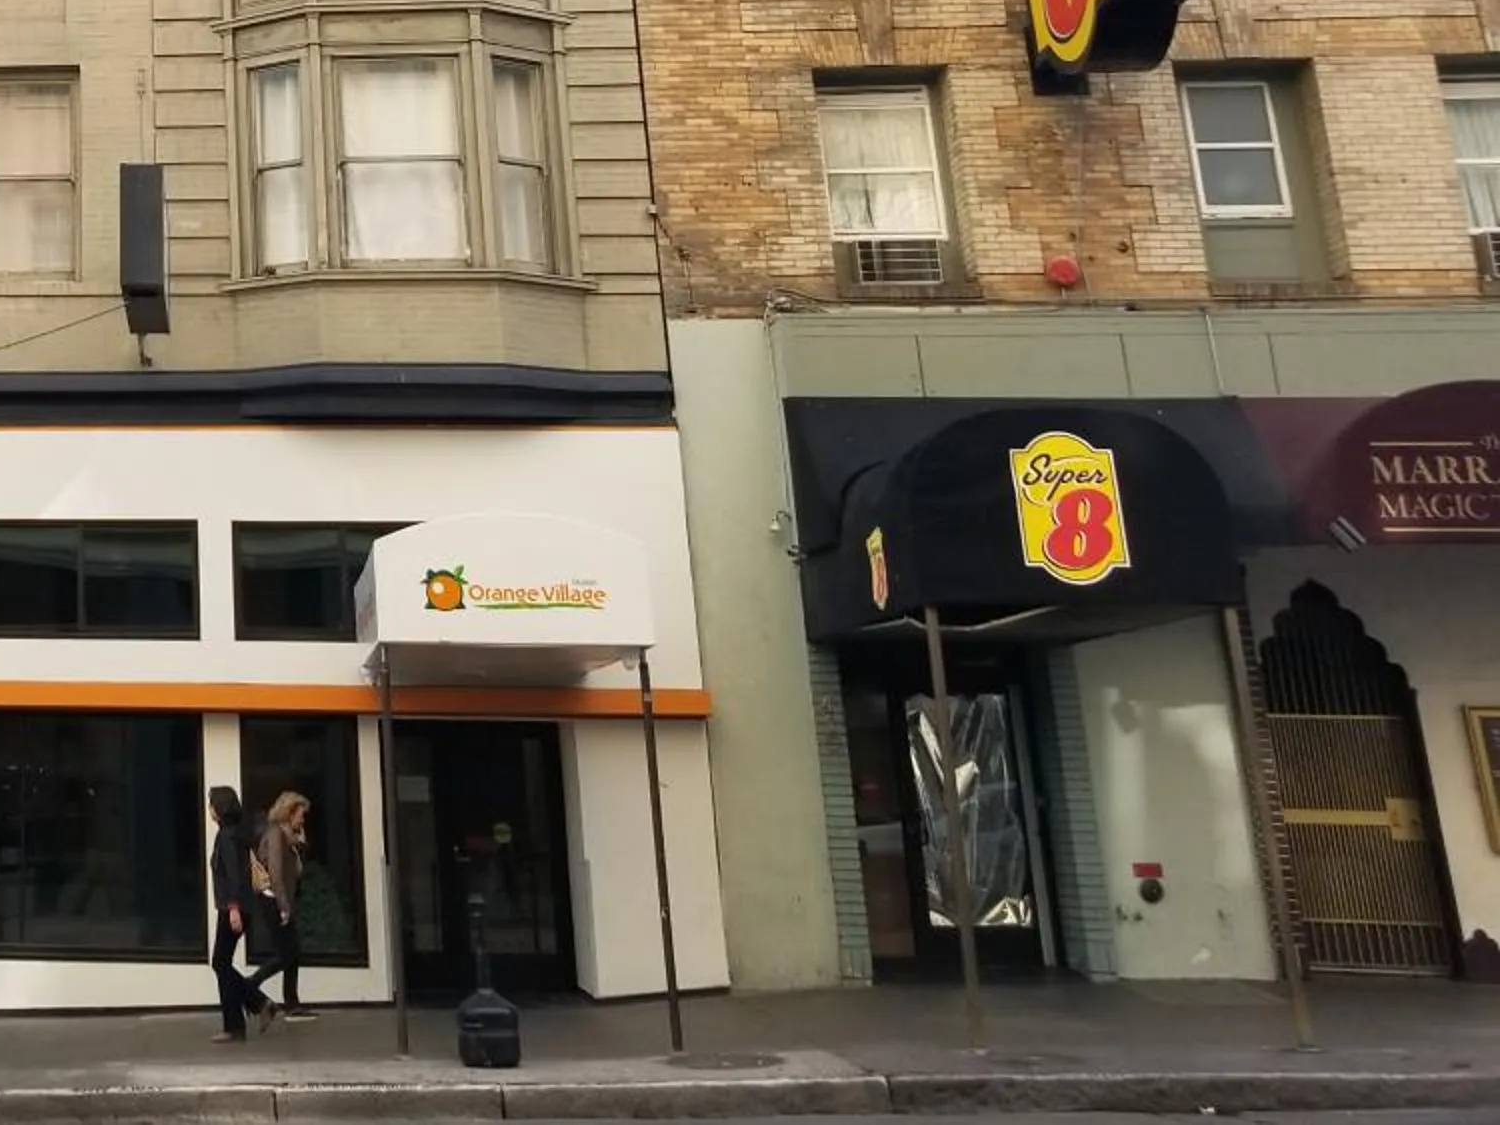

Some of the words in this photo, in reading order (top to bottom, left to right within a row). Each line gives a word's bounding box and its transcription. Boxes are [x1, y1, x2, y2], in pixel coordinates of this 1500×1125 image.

[1022, 453, 1108, 501] Super
[1370, 455, 1500, 484] MARR
[1378, 492, 1491, 520] MAGIC
[1043, 488, 1114, 570] 8
[468, 584, 539, 605] Orange
[541, 582, 606, 605] Village
